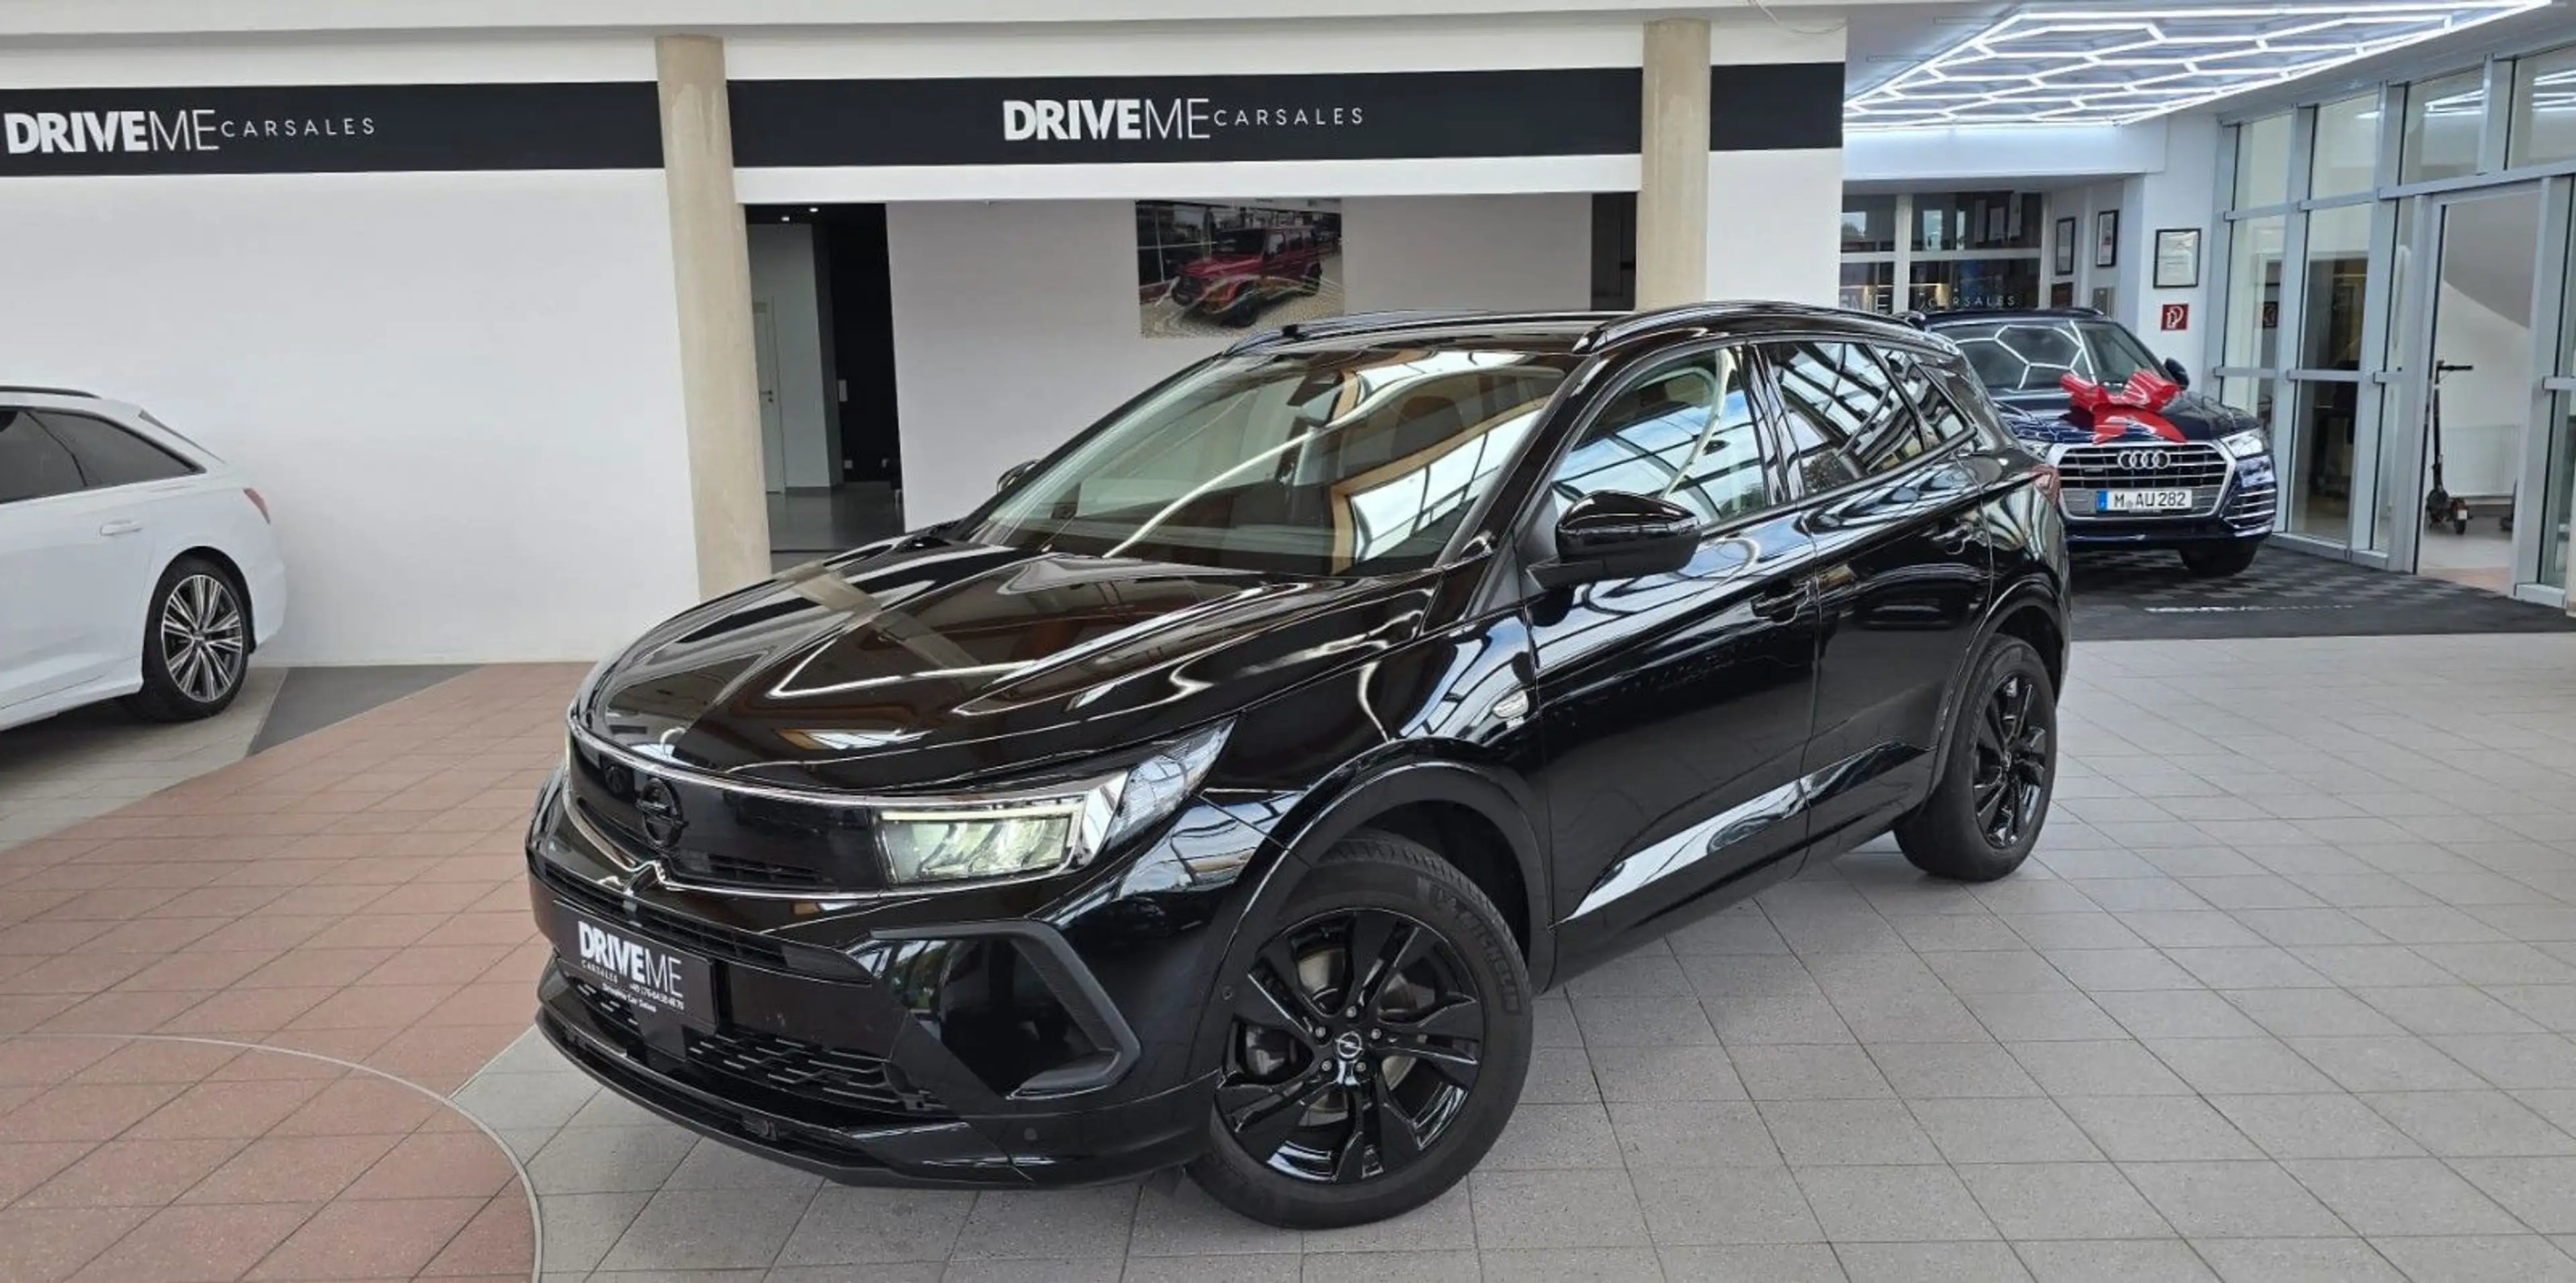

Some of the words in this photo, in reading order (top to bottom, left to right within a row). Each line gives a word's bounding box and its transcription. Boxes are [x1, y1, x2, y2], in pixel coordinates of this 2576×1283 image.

[3, 109, 219, 154] DRIVEME
[221, 117, 376, 138] CARSALES
[1002, 99, 1211, 142] DRIVEME
[1214, 107, 1364, 127] CARSALES
[578, 920, 684, 998] DRIVEME
